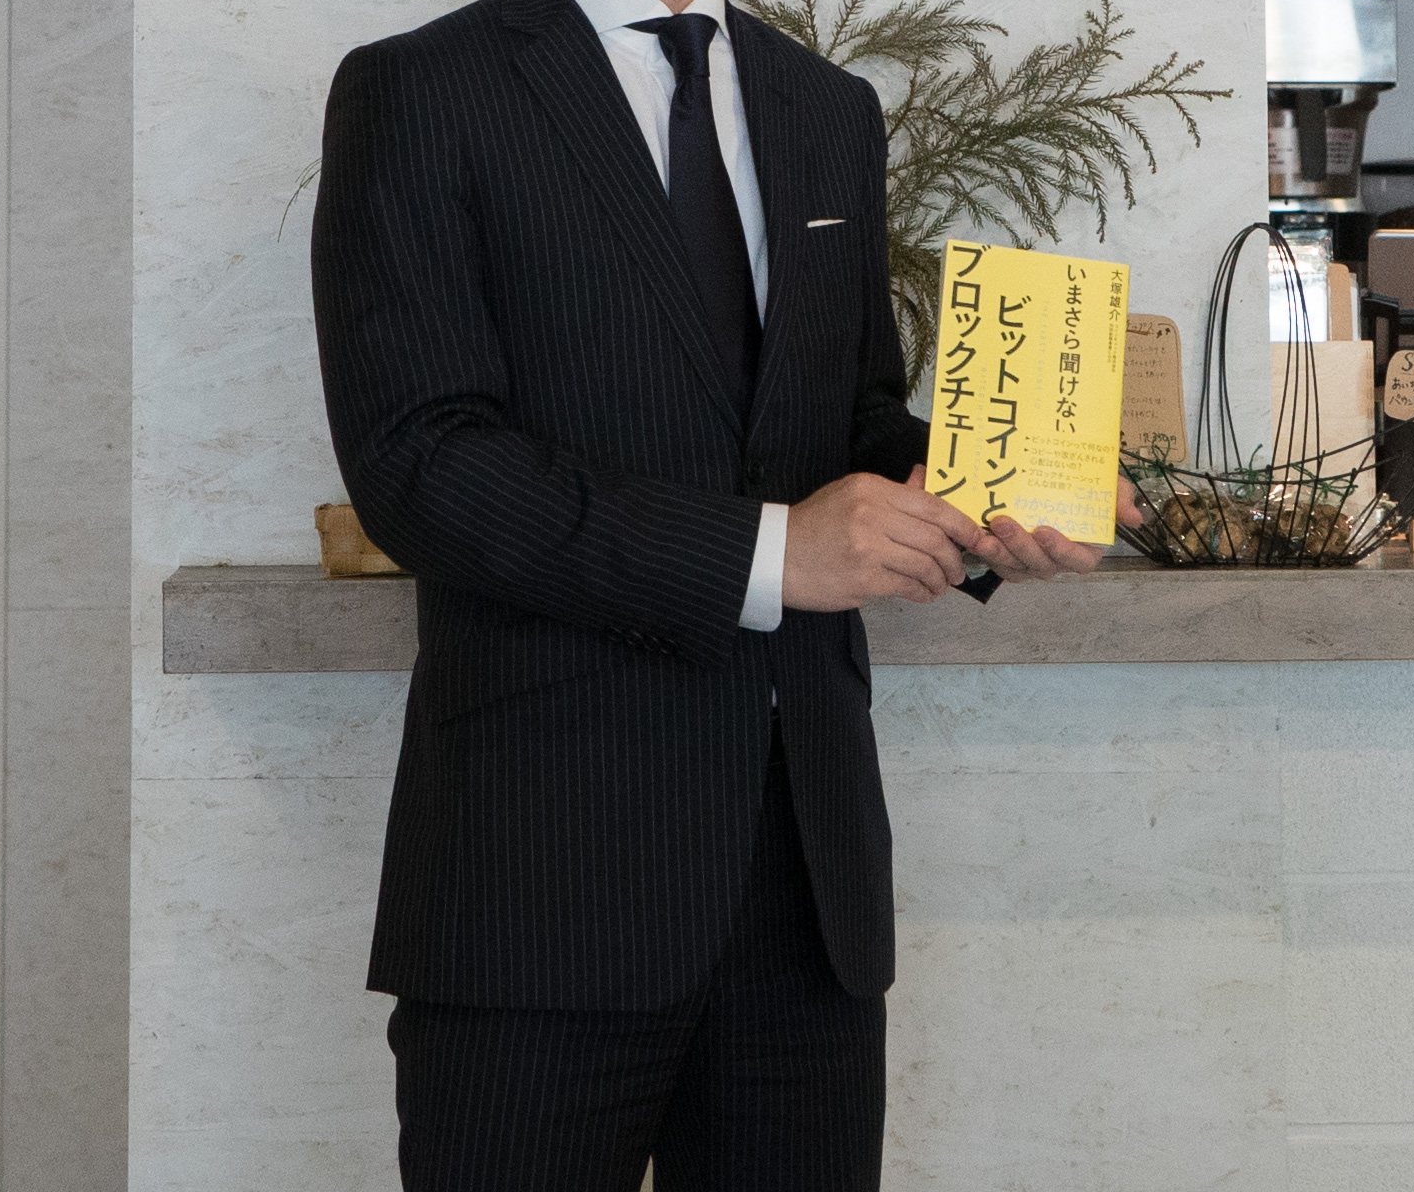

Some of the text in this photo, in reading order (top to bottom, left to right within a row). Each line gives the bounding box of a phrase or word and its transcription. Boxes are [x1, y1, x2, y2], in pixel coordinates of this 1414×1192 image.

[934, 244, 991, 498] ブロックチェーン
[1055, 264, 1087, 433] いまさら聞けない
[1109, 269, 1123, 321] 大塚雄介
[980, 294, 1032, 527] ビットコインと
